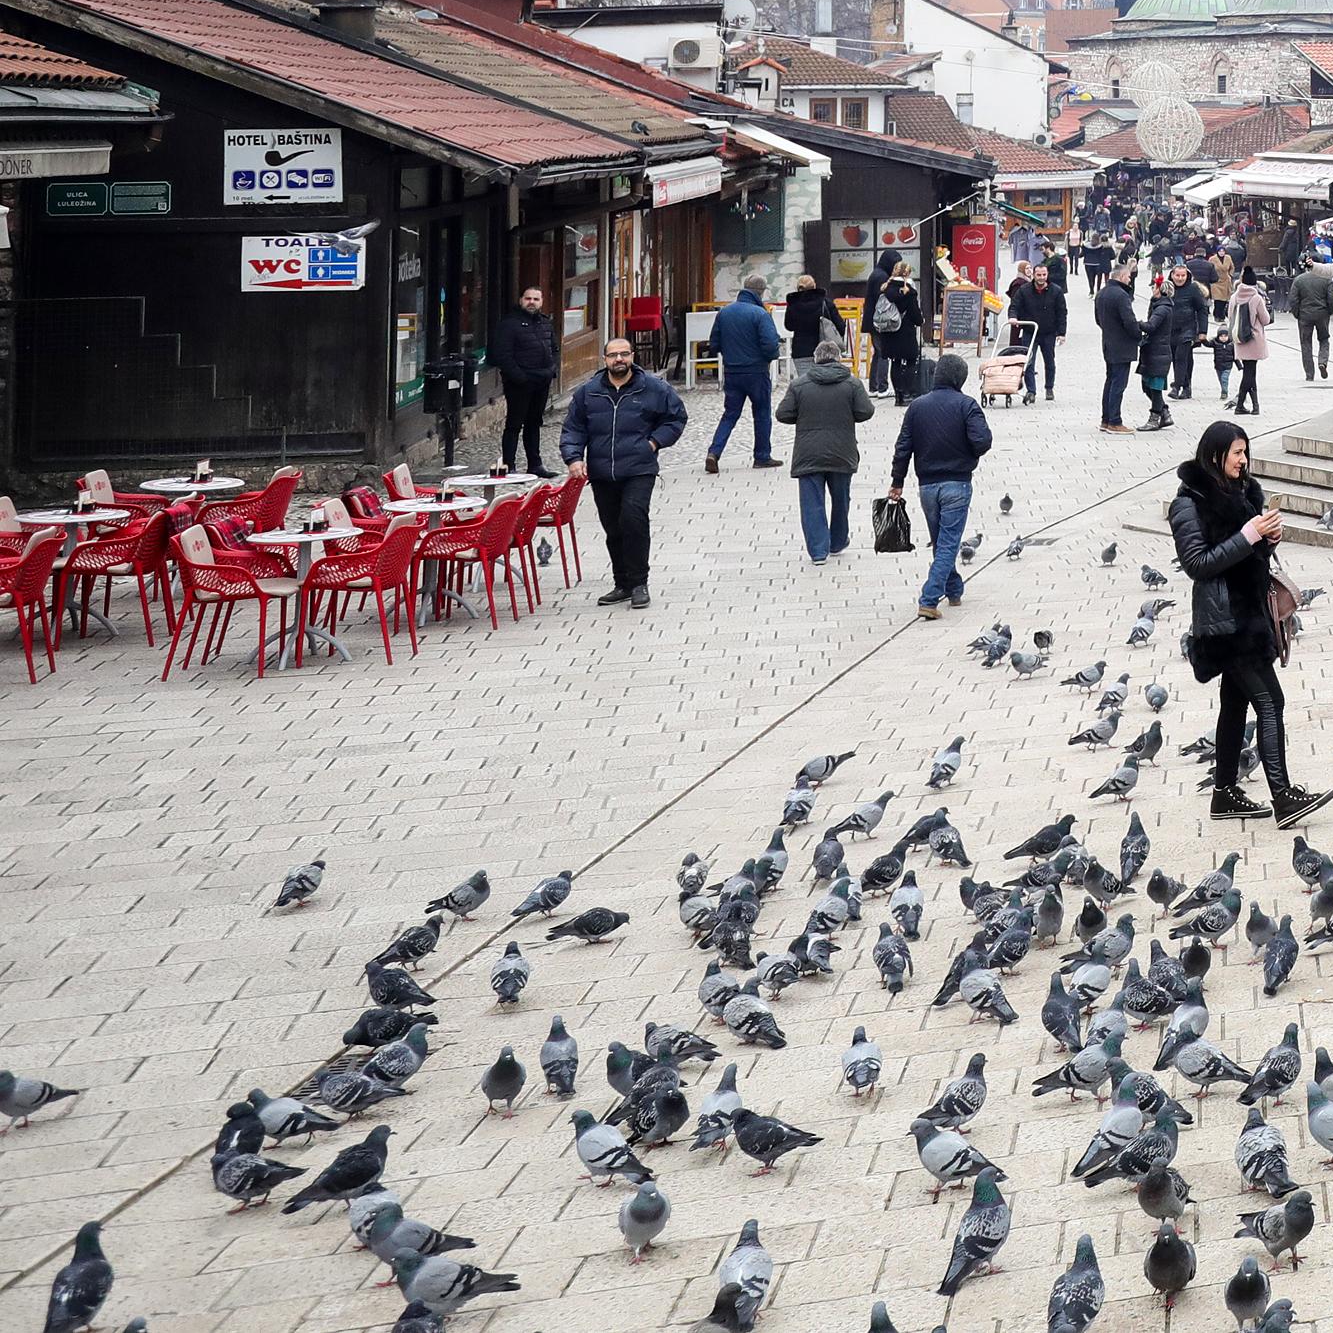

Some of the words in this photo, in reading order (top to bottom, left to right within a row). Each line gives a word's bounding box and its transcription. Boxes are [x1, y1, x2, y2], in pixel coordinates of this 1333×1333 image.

[227, 134, 268, 146] HOTEL
[277, 131, 332, 146] BAŠTINA
[262, 238, 331, 247] TOALE
[248, 258, 302, 274] WC
